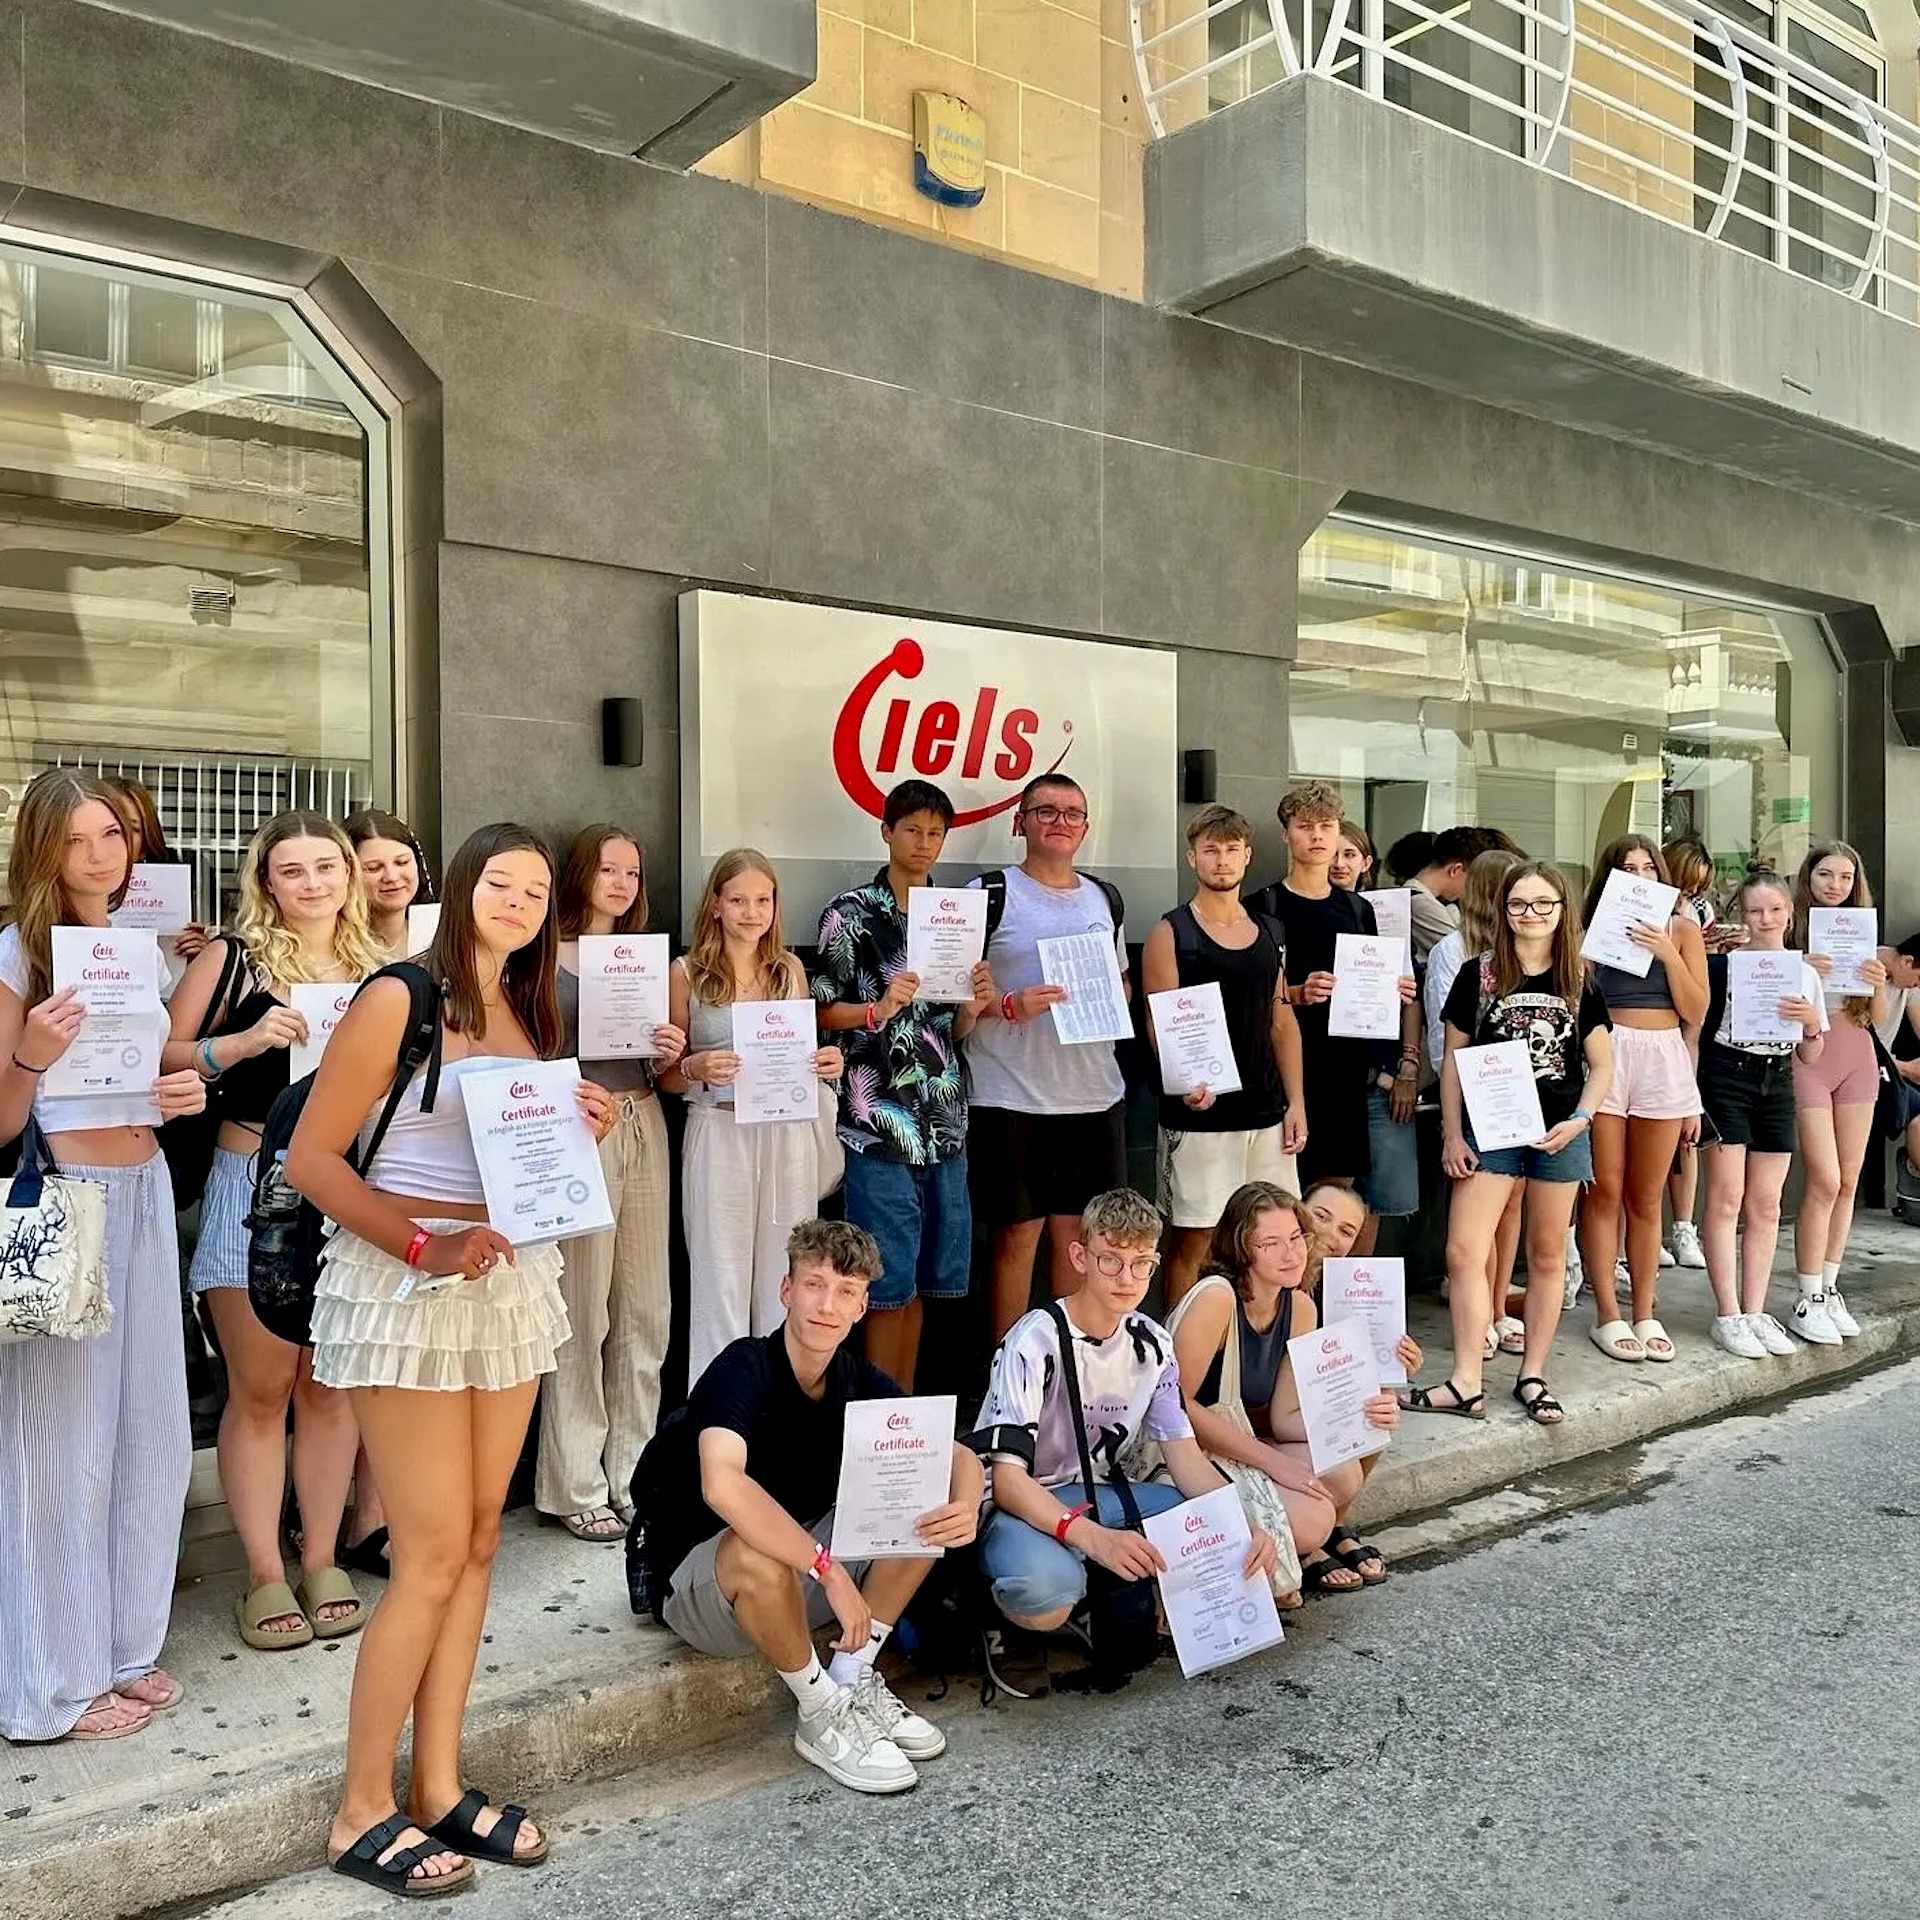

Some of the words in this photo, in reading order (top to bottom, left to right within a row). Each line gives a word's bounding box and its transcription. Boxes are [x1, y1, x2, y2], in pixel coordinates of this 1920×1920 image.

[121, 898, 164, 908] ertificate
[930, 916, 967, 925] Certificate
[82, 968, 130, 981] Certificate
[604, 964, 646, 974] Certificate
[1750, 972, 1784, 980] Certificate
[1172, 1013, 1205, 1025] Certificate
[757, 1029, 796, 1040] Certificate
[1478, 1067, 1513, 1079] Certificate
[501, 1105, 557, 1122] Certificate
[1344, 1288, 1383, 1298] Certificate
[1316, 1354, 1353, 1374] Certificate
[874, 1438, 925, 1451] Certificate
[1181, 1532, 1226, 1557] Certificate
